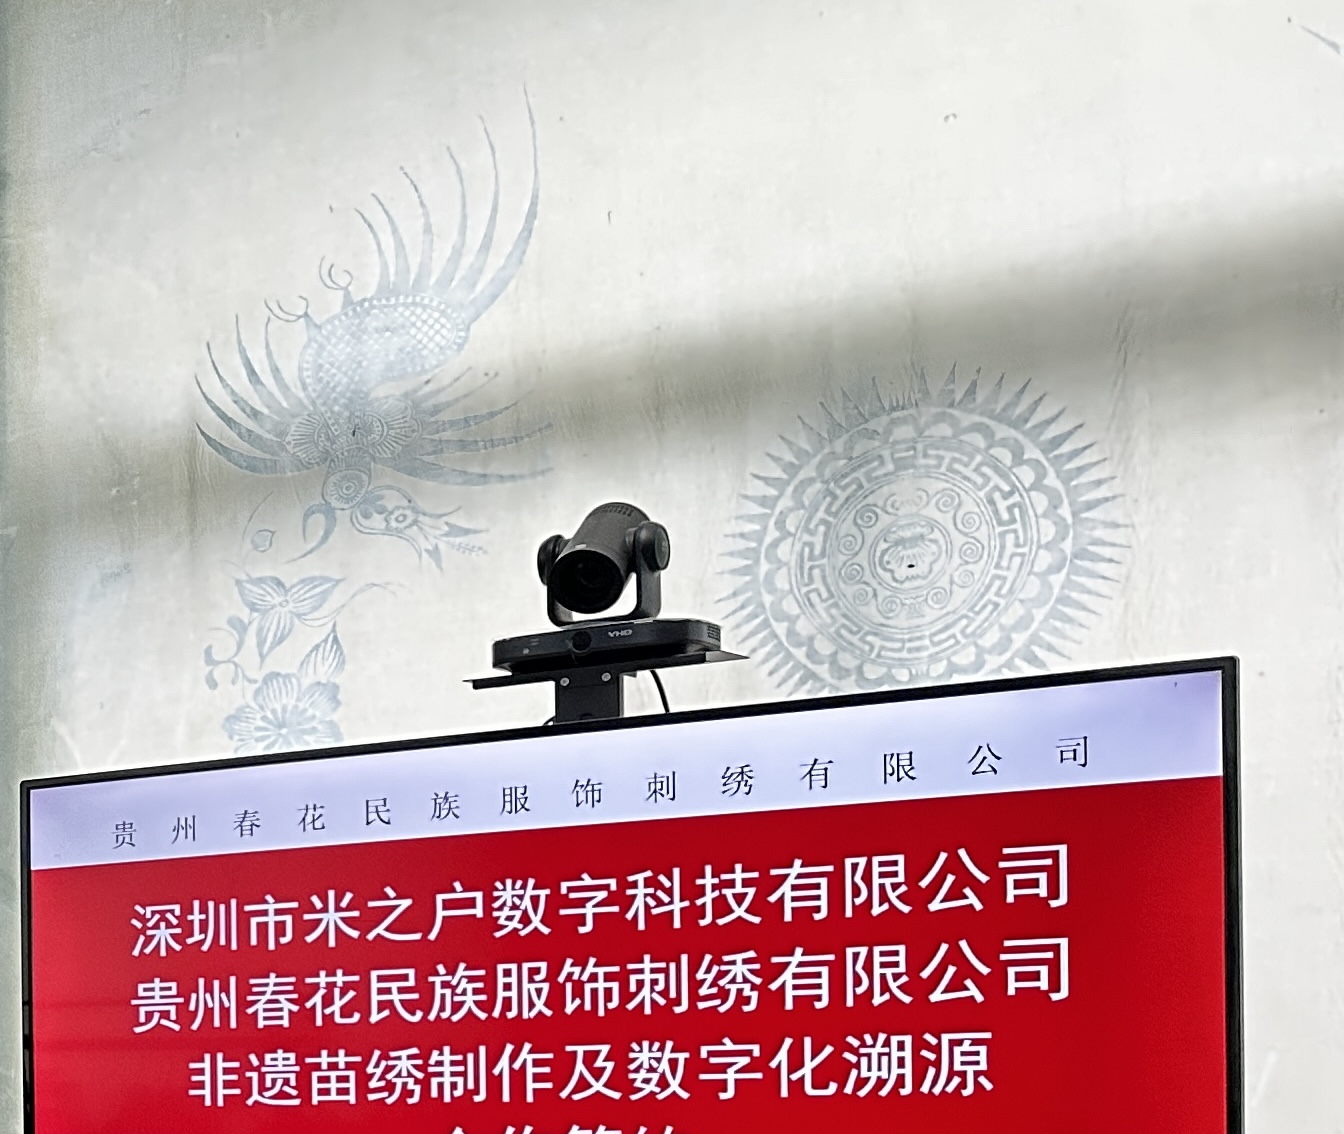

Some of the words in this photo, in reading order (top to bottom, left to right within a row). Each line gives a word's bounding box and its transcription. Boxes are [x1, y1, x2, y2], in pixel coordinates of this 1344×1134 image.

[111, 734, 1092, 850] 贵州春花民族服饰刺绣有限公司
[130, 842, 1069, 957] 深圳市米之户数字科技有限公司
[132, 936, 1071, 1033] 贵州春花民族服饰刺绣有限公司
[187, 1030, 993, 1110] 非遗苗绣制作及数字化溯源
